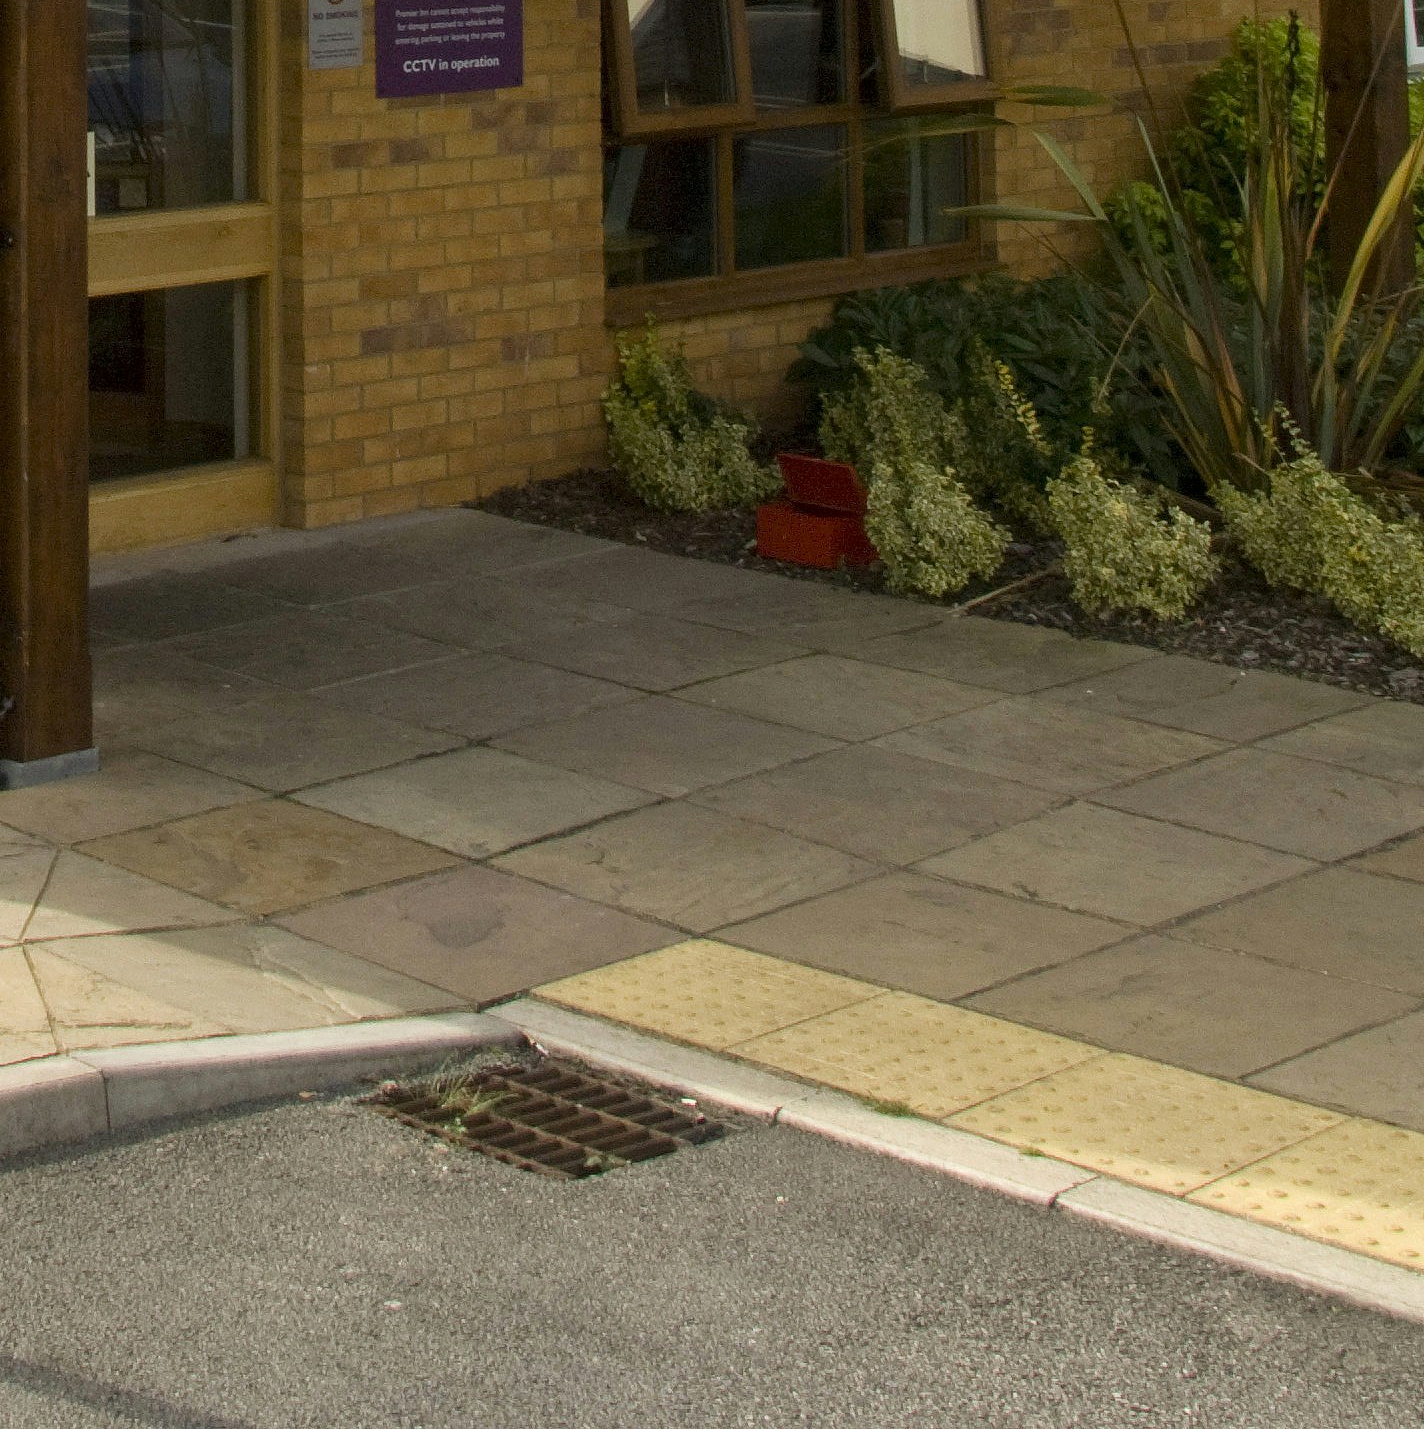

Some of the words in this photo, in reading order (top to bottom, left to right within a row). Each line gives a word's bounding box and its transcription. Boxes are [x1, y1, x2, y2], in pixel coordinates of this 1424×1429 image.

[403, 59, 437, 73] CCTV
[438, 58, 449, 71] in
[450, 54, 500, 73] operation
